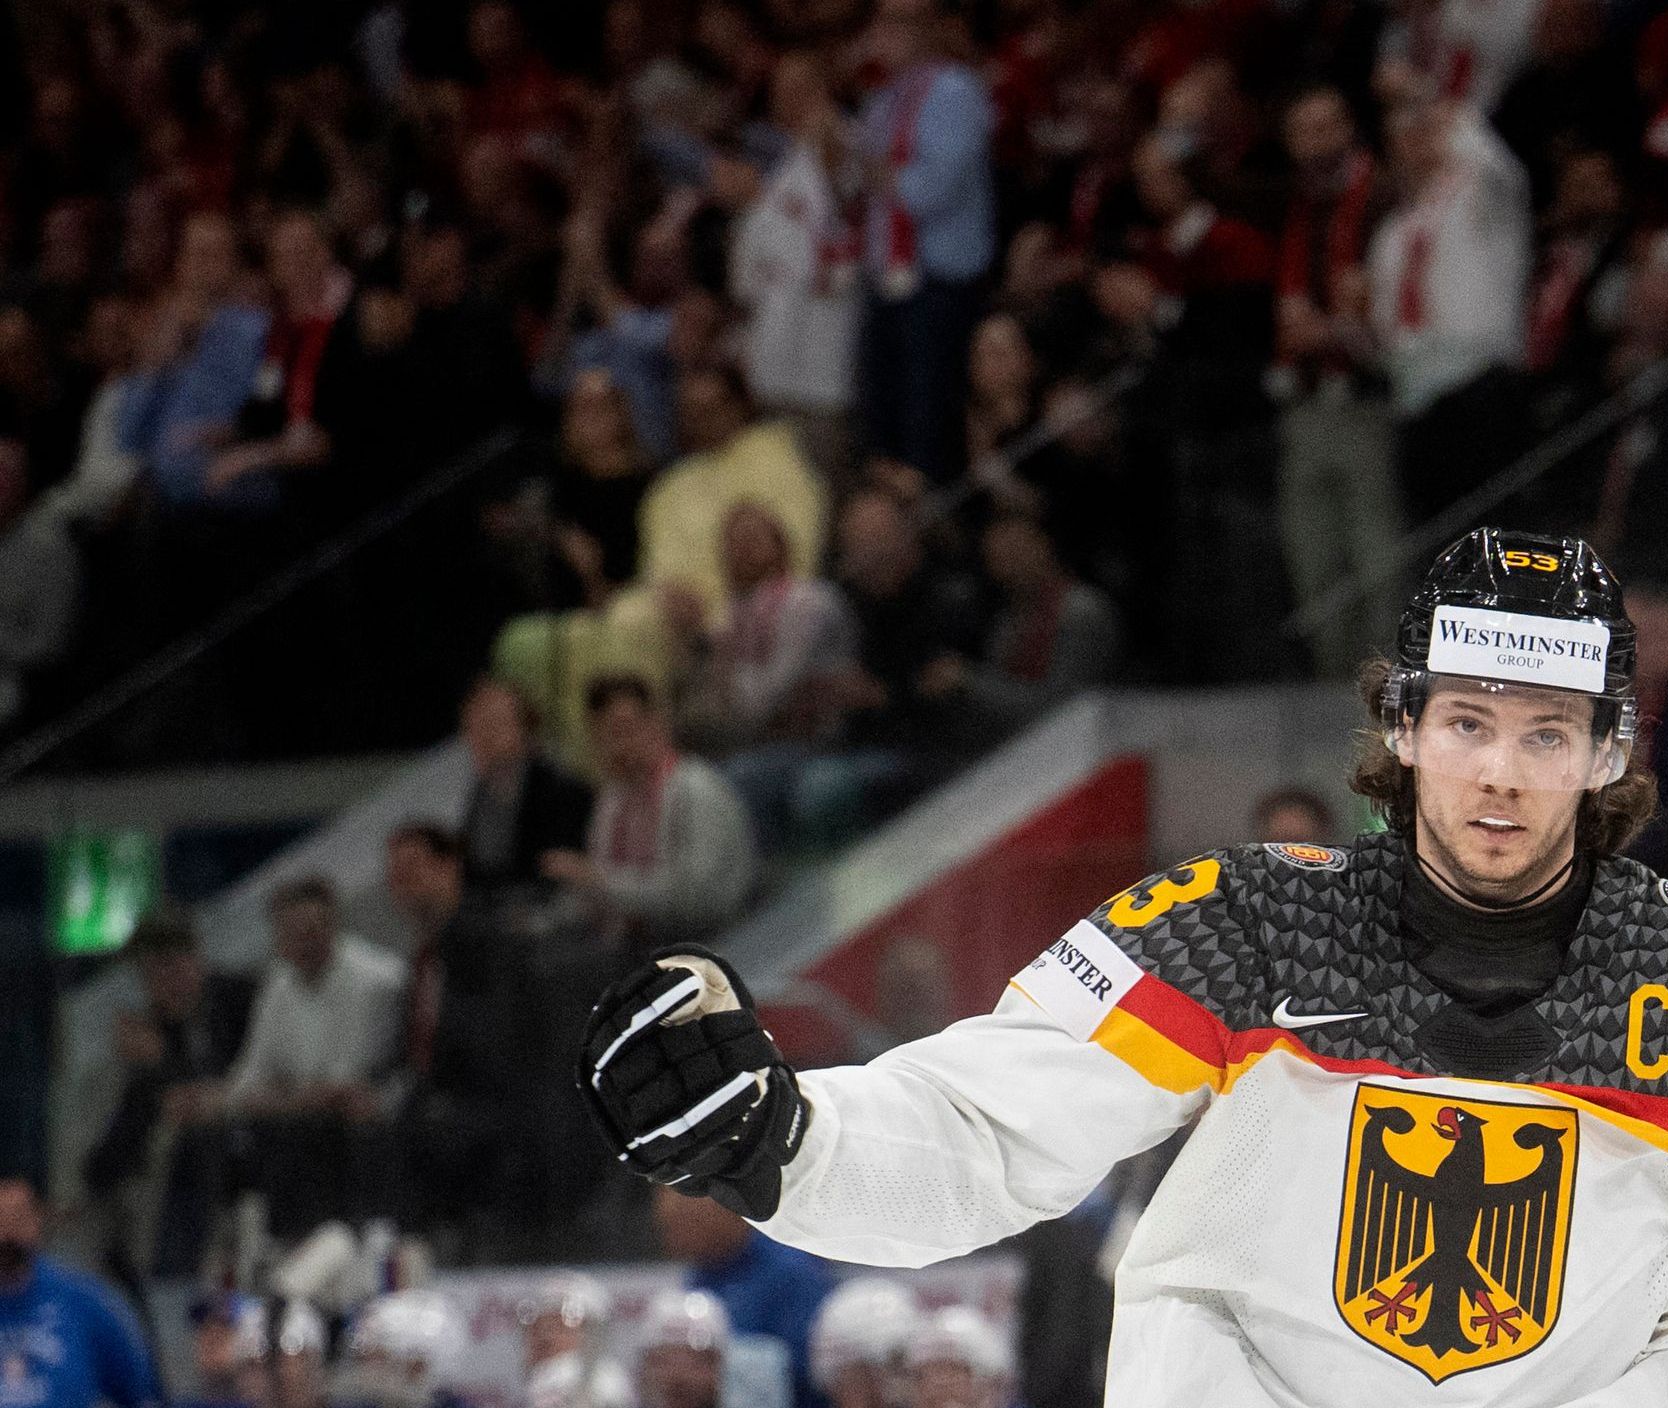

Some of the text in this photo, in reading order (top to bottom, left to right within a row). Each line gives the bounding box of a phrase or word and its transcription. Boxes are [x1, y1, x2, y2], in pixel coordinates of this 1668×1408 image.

[1503, 551, 1559, 573] 53
[1439, 618, 1602, 662] WESTMINSTER
[1496, 652, 1545, 670] GROUP
